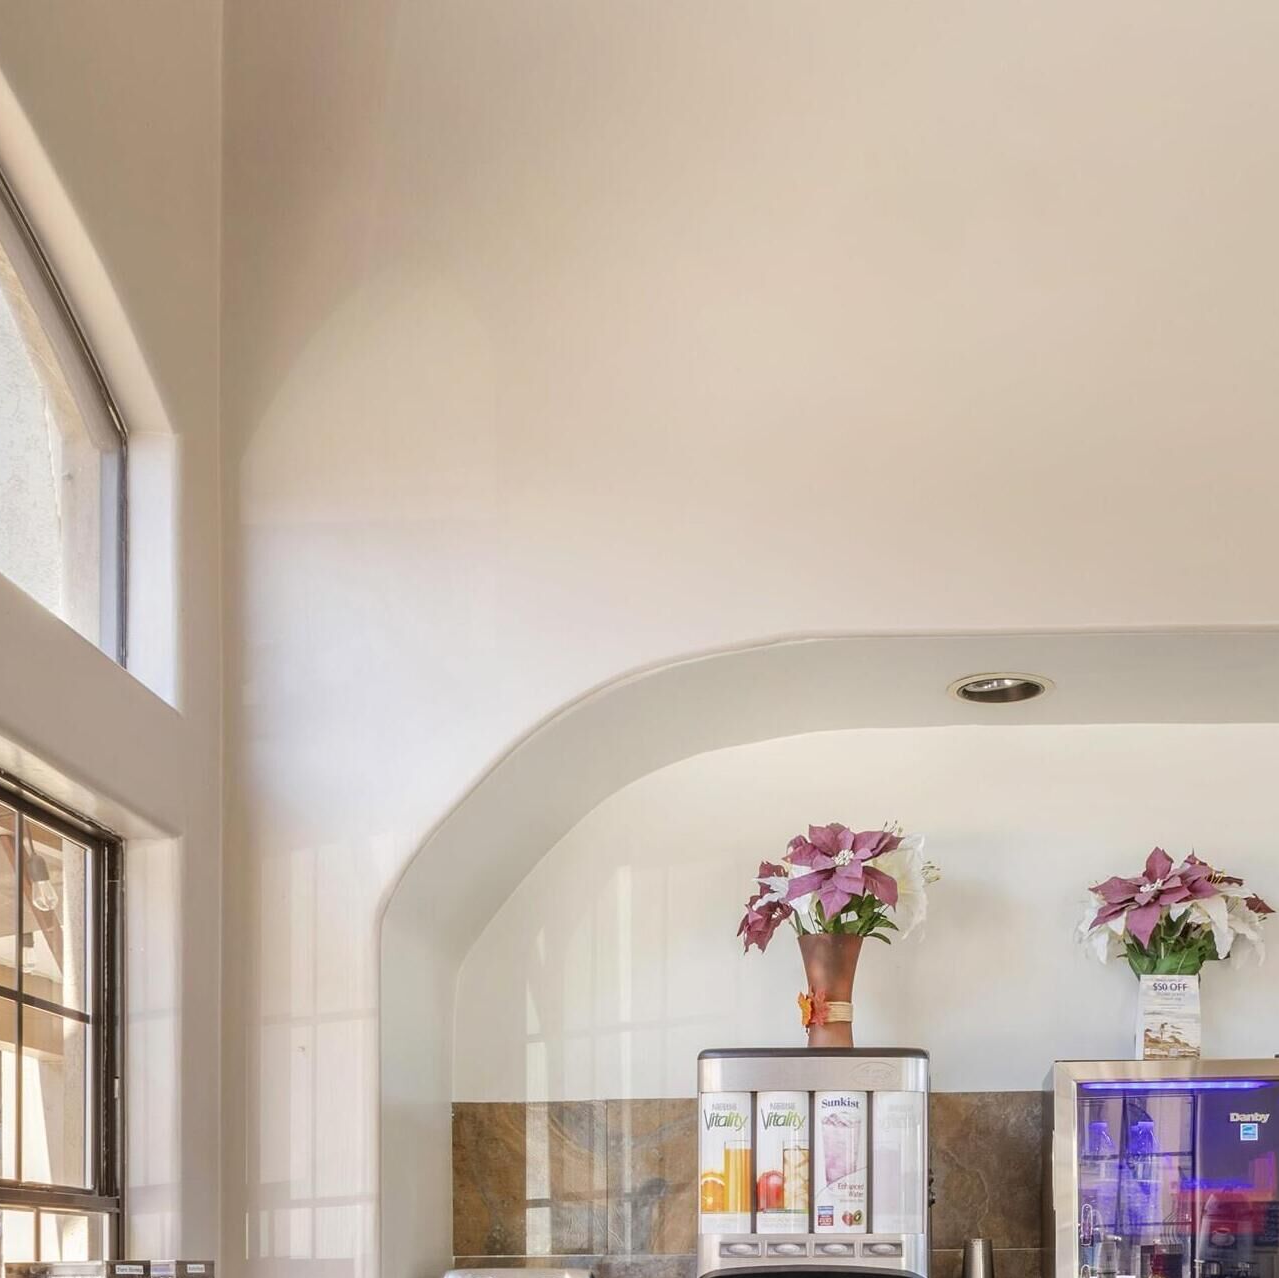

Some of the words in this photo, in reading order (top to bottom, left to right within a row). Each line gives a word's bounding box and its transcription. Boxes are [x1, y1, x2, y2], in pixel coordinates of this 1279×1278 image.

[1169, 982, 1189, 992] OFF
[821, 1097, 860, 1110] Sunkist
[703, 1108, 749, 1132] Vitality
[760, 1108, 807, 1132] Vitality
[1229, 1112, 1270, 1124] Danby
